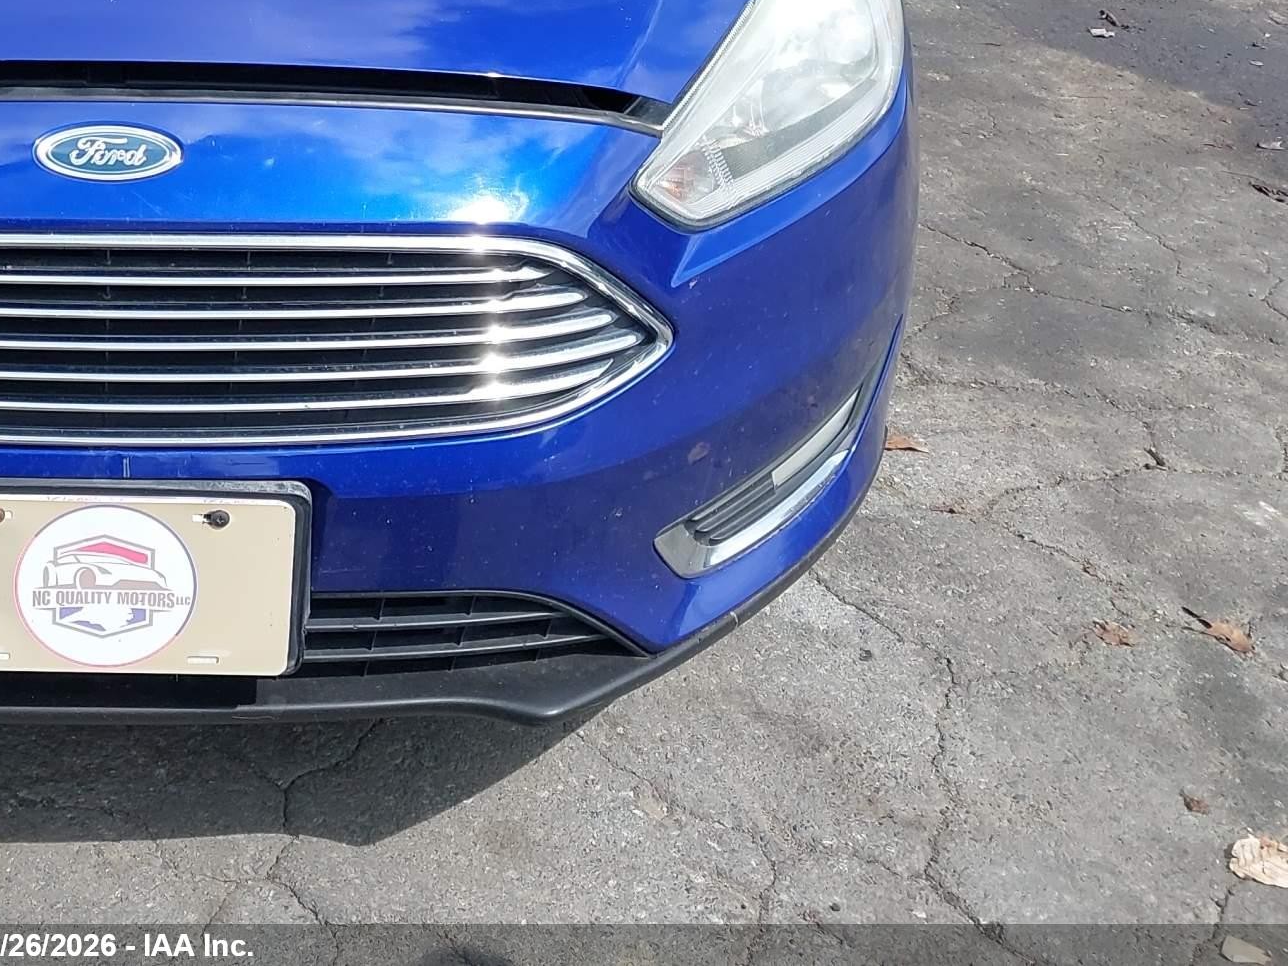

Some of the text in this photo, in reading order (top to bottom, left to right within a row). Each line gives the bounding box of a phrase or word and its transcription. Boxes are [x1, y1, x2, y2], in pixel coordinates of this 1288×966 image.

[69, 136, 147, 166] Ford
[32, 590, 191, 609] NC QUALITY MOTORS LLC
